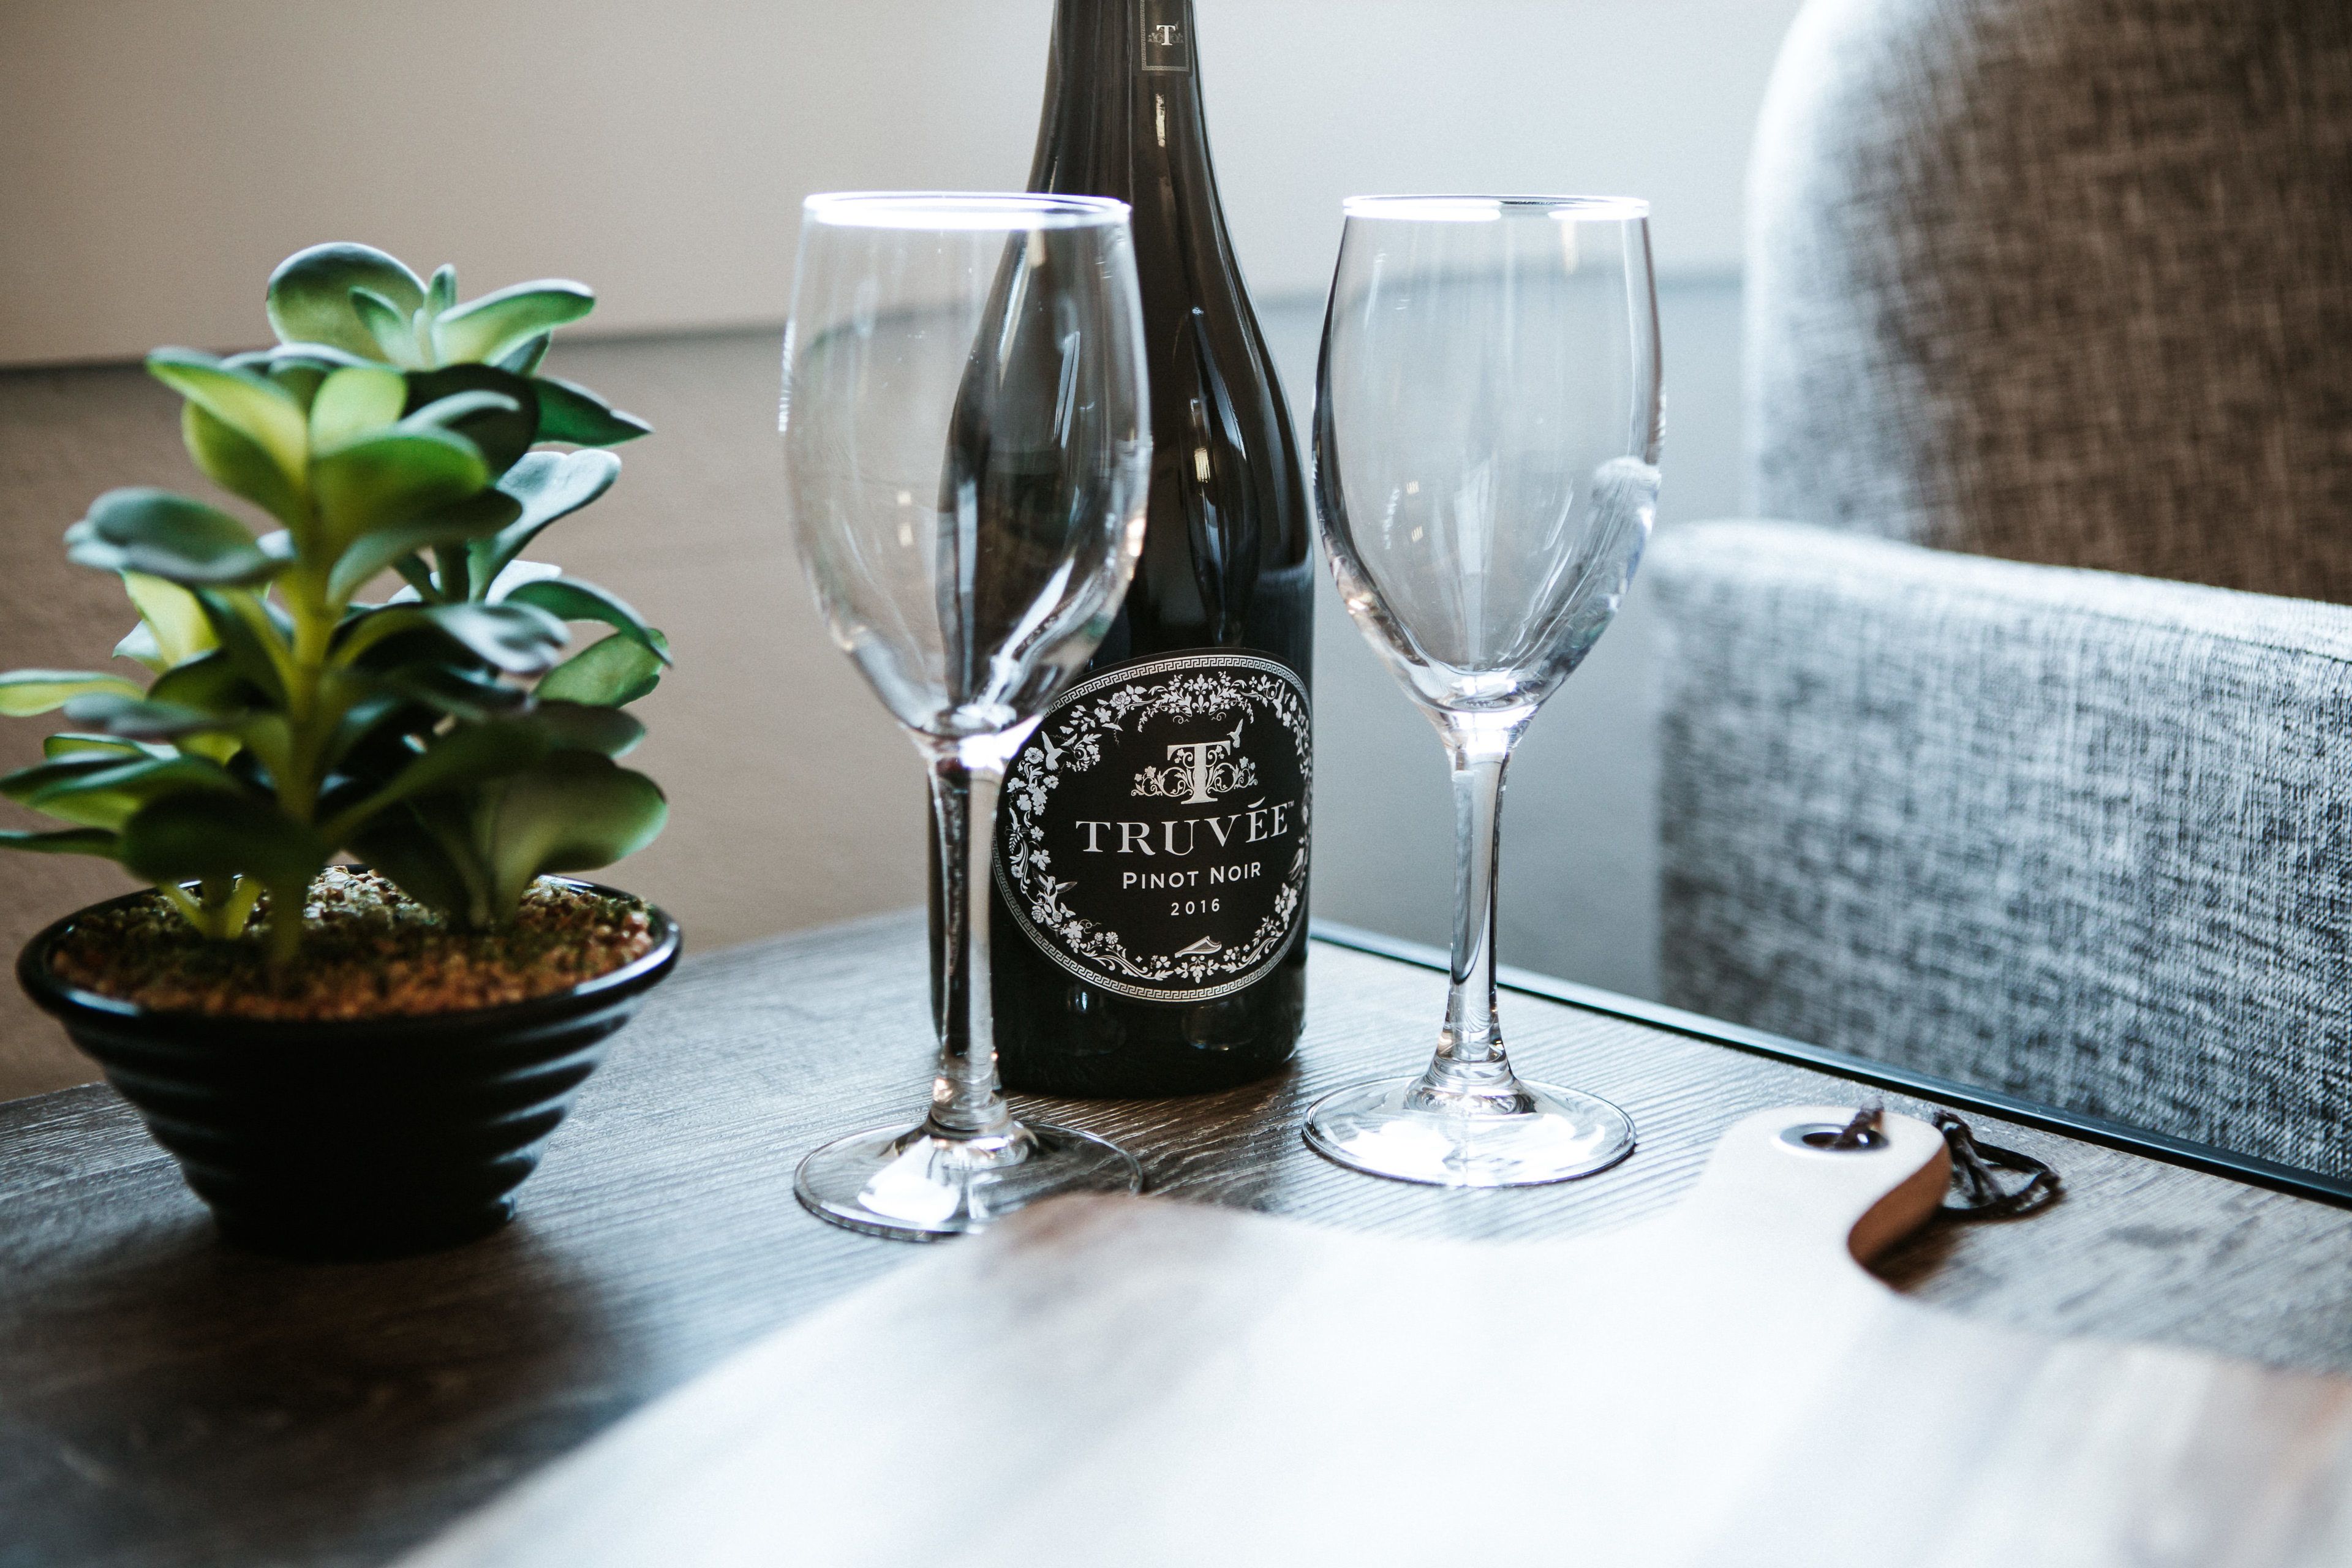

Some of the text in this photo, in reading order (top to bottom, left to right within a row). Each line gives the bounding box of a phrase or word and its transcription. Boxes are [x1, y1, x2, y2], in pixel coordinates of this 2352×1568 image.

[1156, 24, 1175, 46] T
[1167, 740, 1231, 805] T
[1123, 861, 1261, 889] PINOT NOIR
[1170, 898, 1220, 916] 2016
